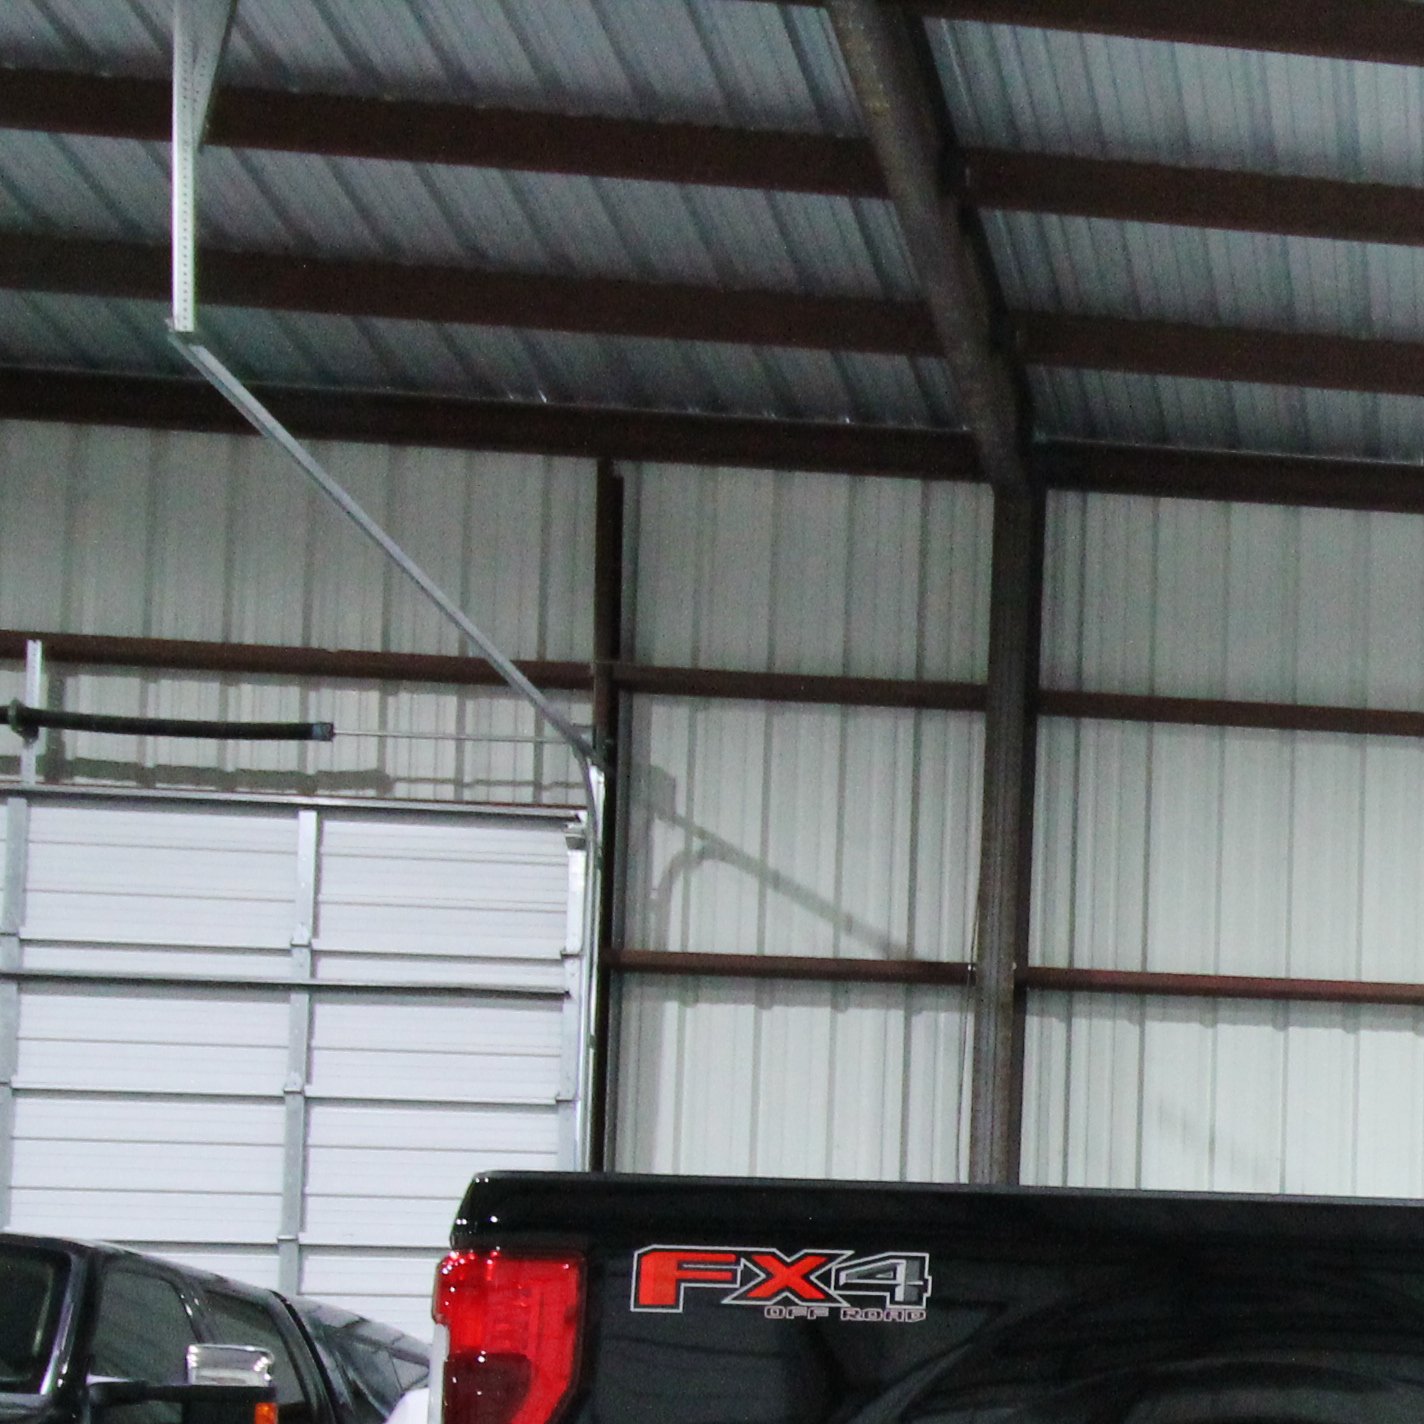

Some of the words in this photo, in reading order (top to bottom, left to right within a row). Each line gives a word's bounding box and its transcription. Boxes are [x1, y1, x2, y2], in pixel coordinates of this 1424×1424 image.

[631, 1244, 932, 1312] FX4
[764, 1305, 829, 1320] OFF
[841, 1307, 926, 1322] ROAD
